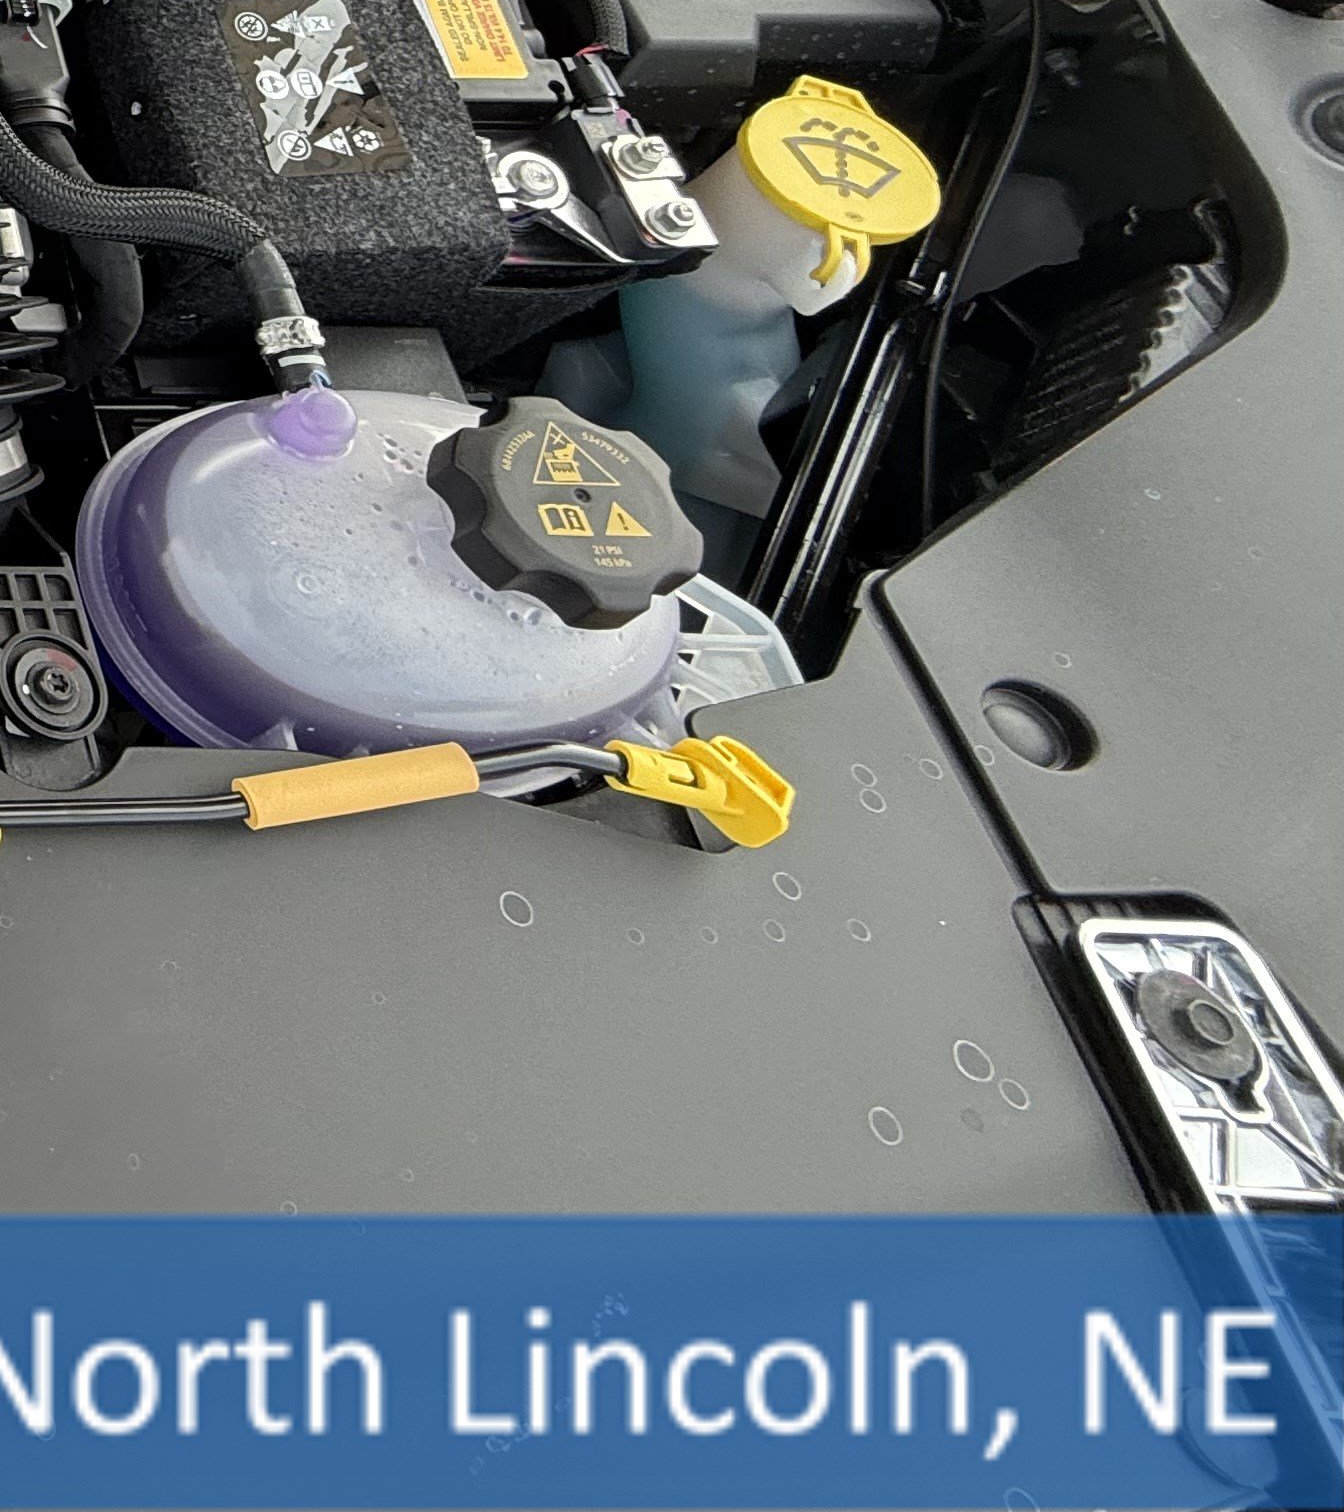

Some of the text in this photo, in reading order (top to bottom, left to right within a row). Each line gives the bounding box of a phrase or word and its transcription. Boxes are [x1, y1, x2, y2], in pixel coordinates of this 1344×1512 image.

[440, 8, 454, 28] AGM
[453, 14, 466, 31] NOT
[448, 28, 469, 62] SEALED
[461, 33, 473, 45] DO
[605, 545, 622, 555] PSI
